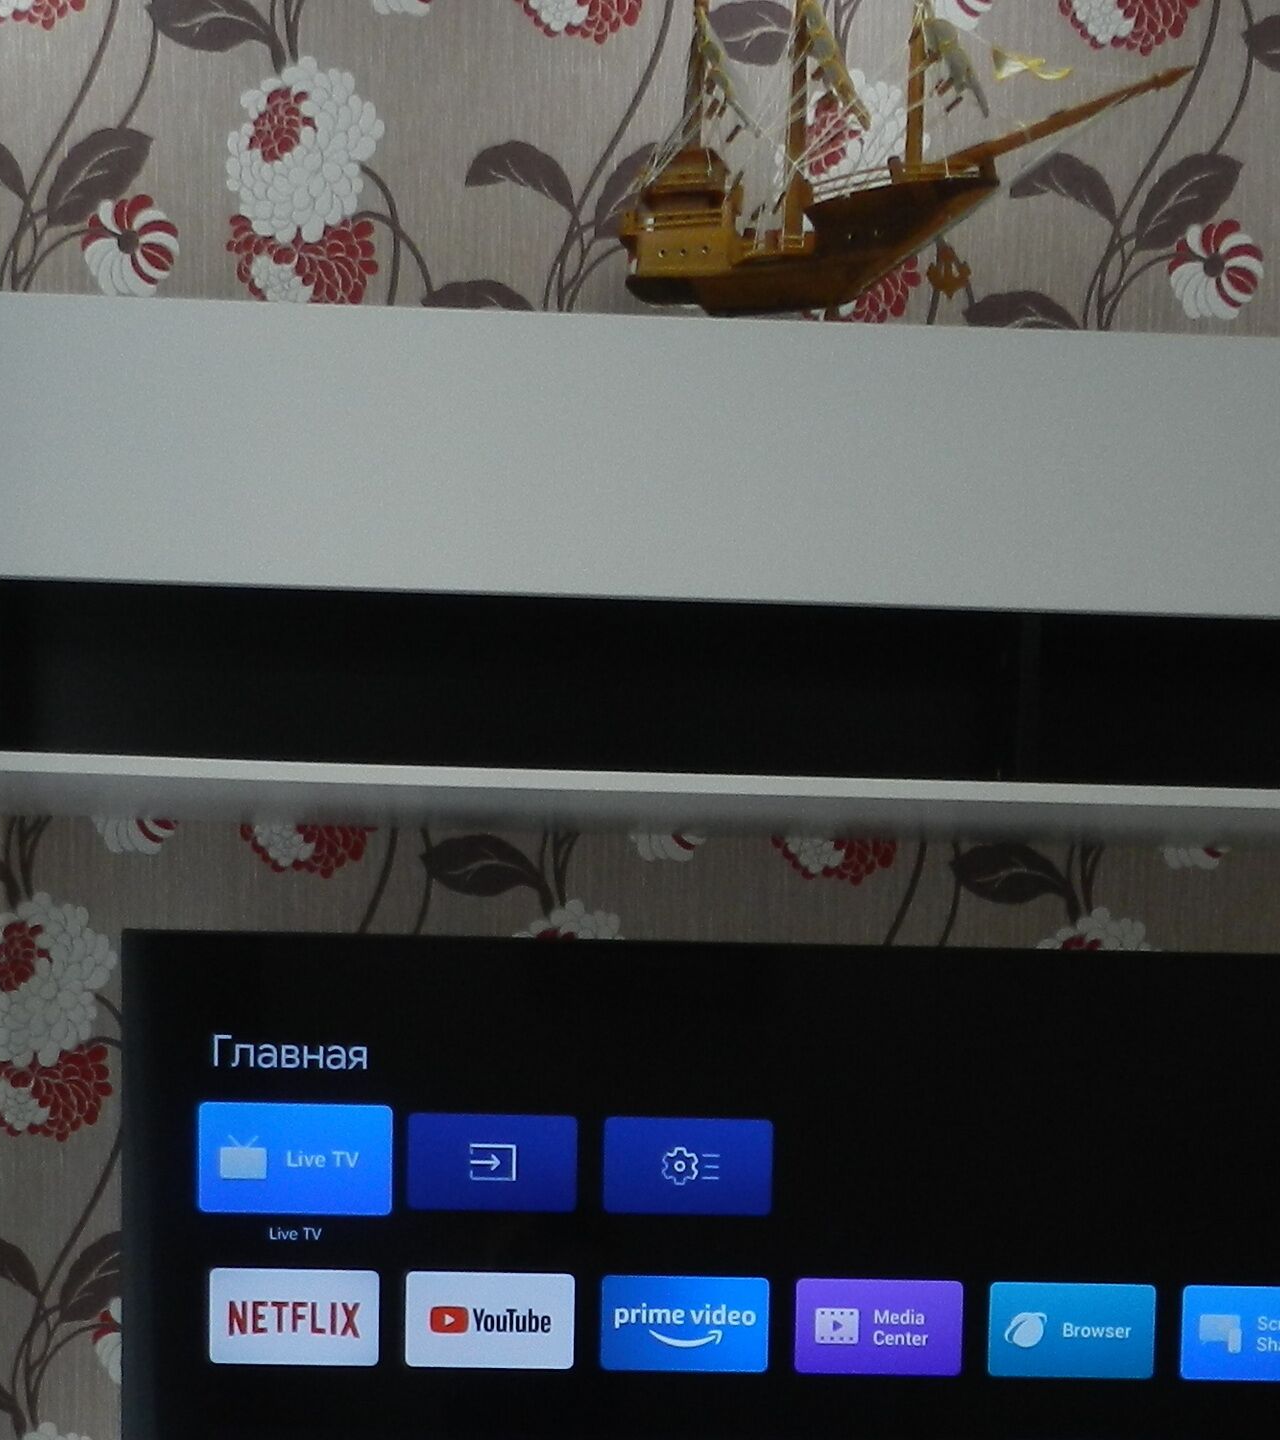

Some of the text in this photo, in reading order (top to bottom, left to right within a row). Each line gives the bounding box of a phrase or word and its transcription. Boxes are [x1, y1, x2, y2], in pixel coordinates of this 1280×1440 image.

[212, 1034, 369, 1071] Главная
[286, 1150, 360, 1169] Live TV
[269, 1226, 322, 1241] Live TV
[227, 1300, 361, 1339] NETFLIX
[472, 1307, 552, 1334] YouTube
[613, 1303, 757, 1330] prime video
[873, 1309, 926, 1326] Media
[872, 1330, 929, 1347] Center
[1062, 1322, 1132, 1340] Browser
